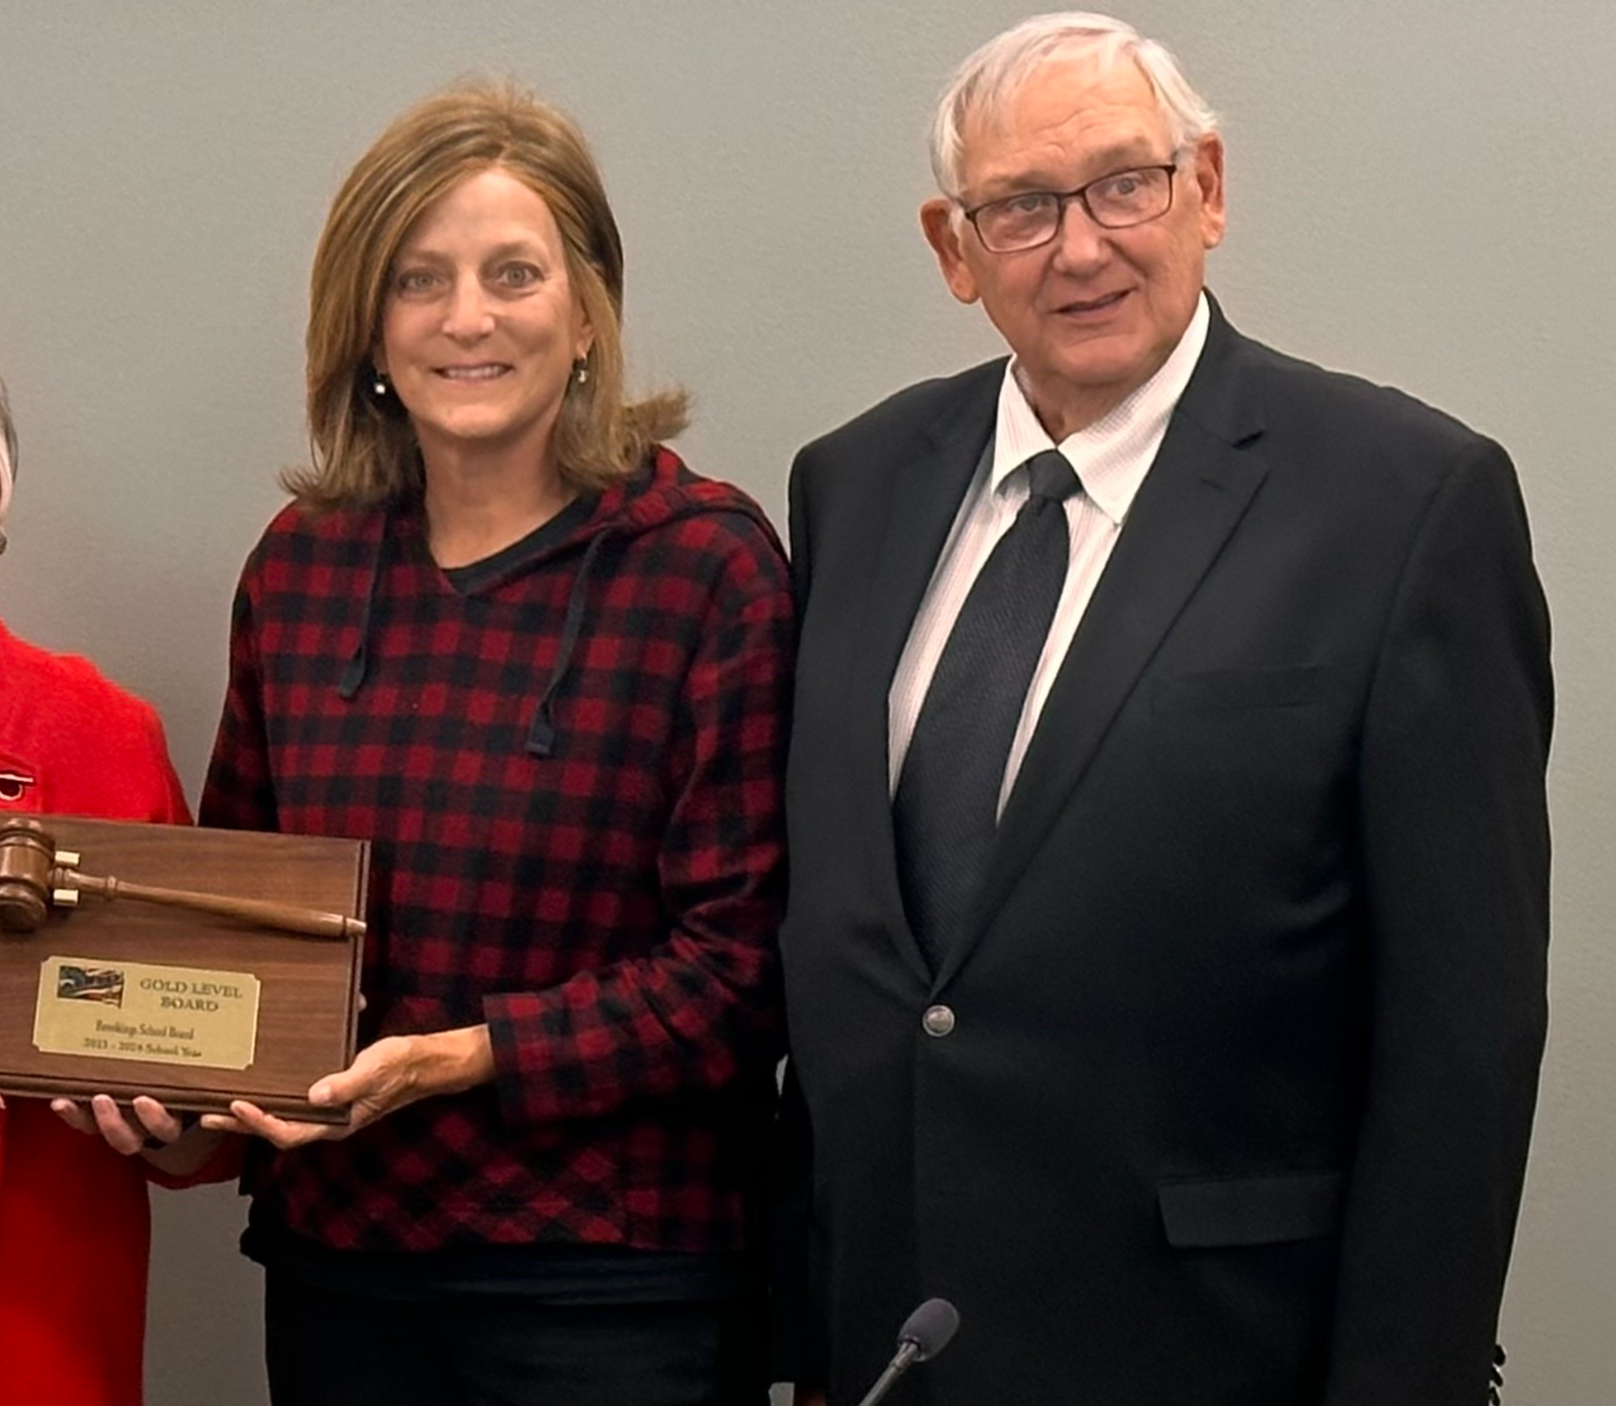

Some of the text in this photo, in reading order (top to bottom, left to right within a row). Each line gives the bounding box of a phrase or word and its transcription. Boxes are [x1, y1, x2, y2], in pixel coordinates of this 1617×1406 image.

[139, 978, 188, 994] GOLD
[191, 982, 243, 999] LEVEL
[160, 996, 219, 1012] BOARD
